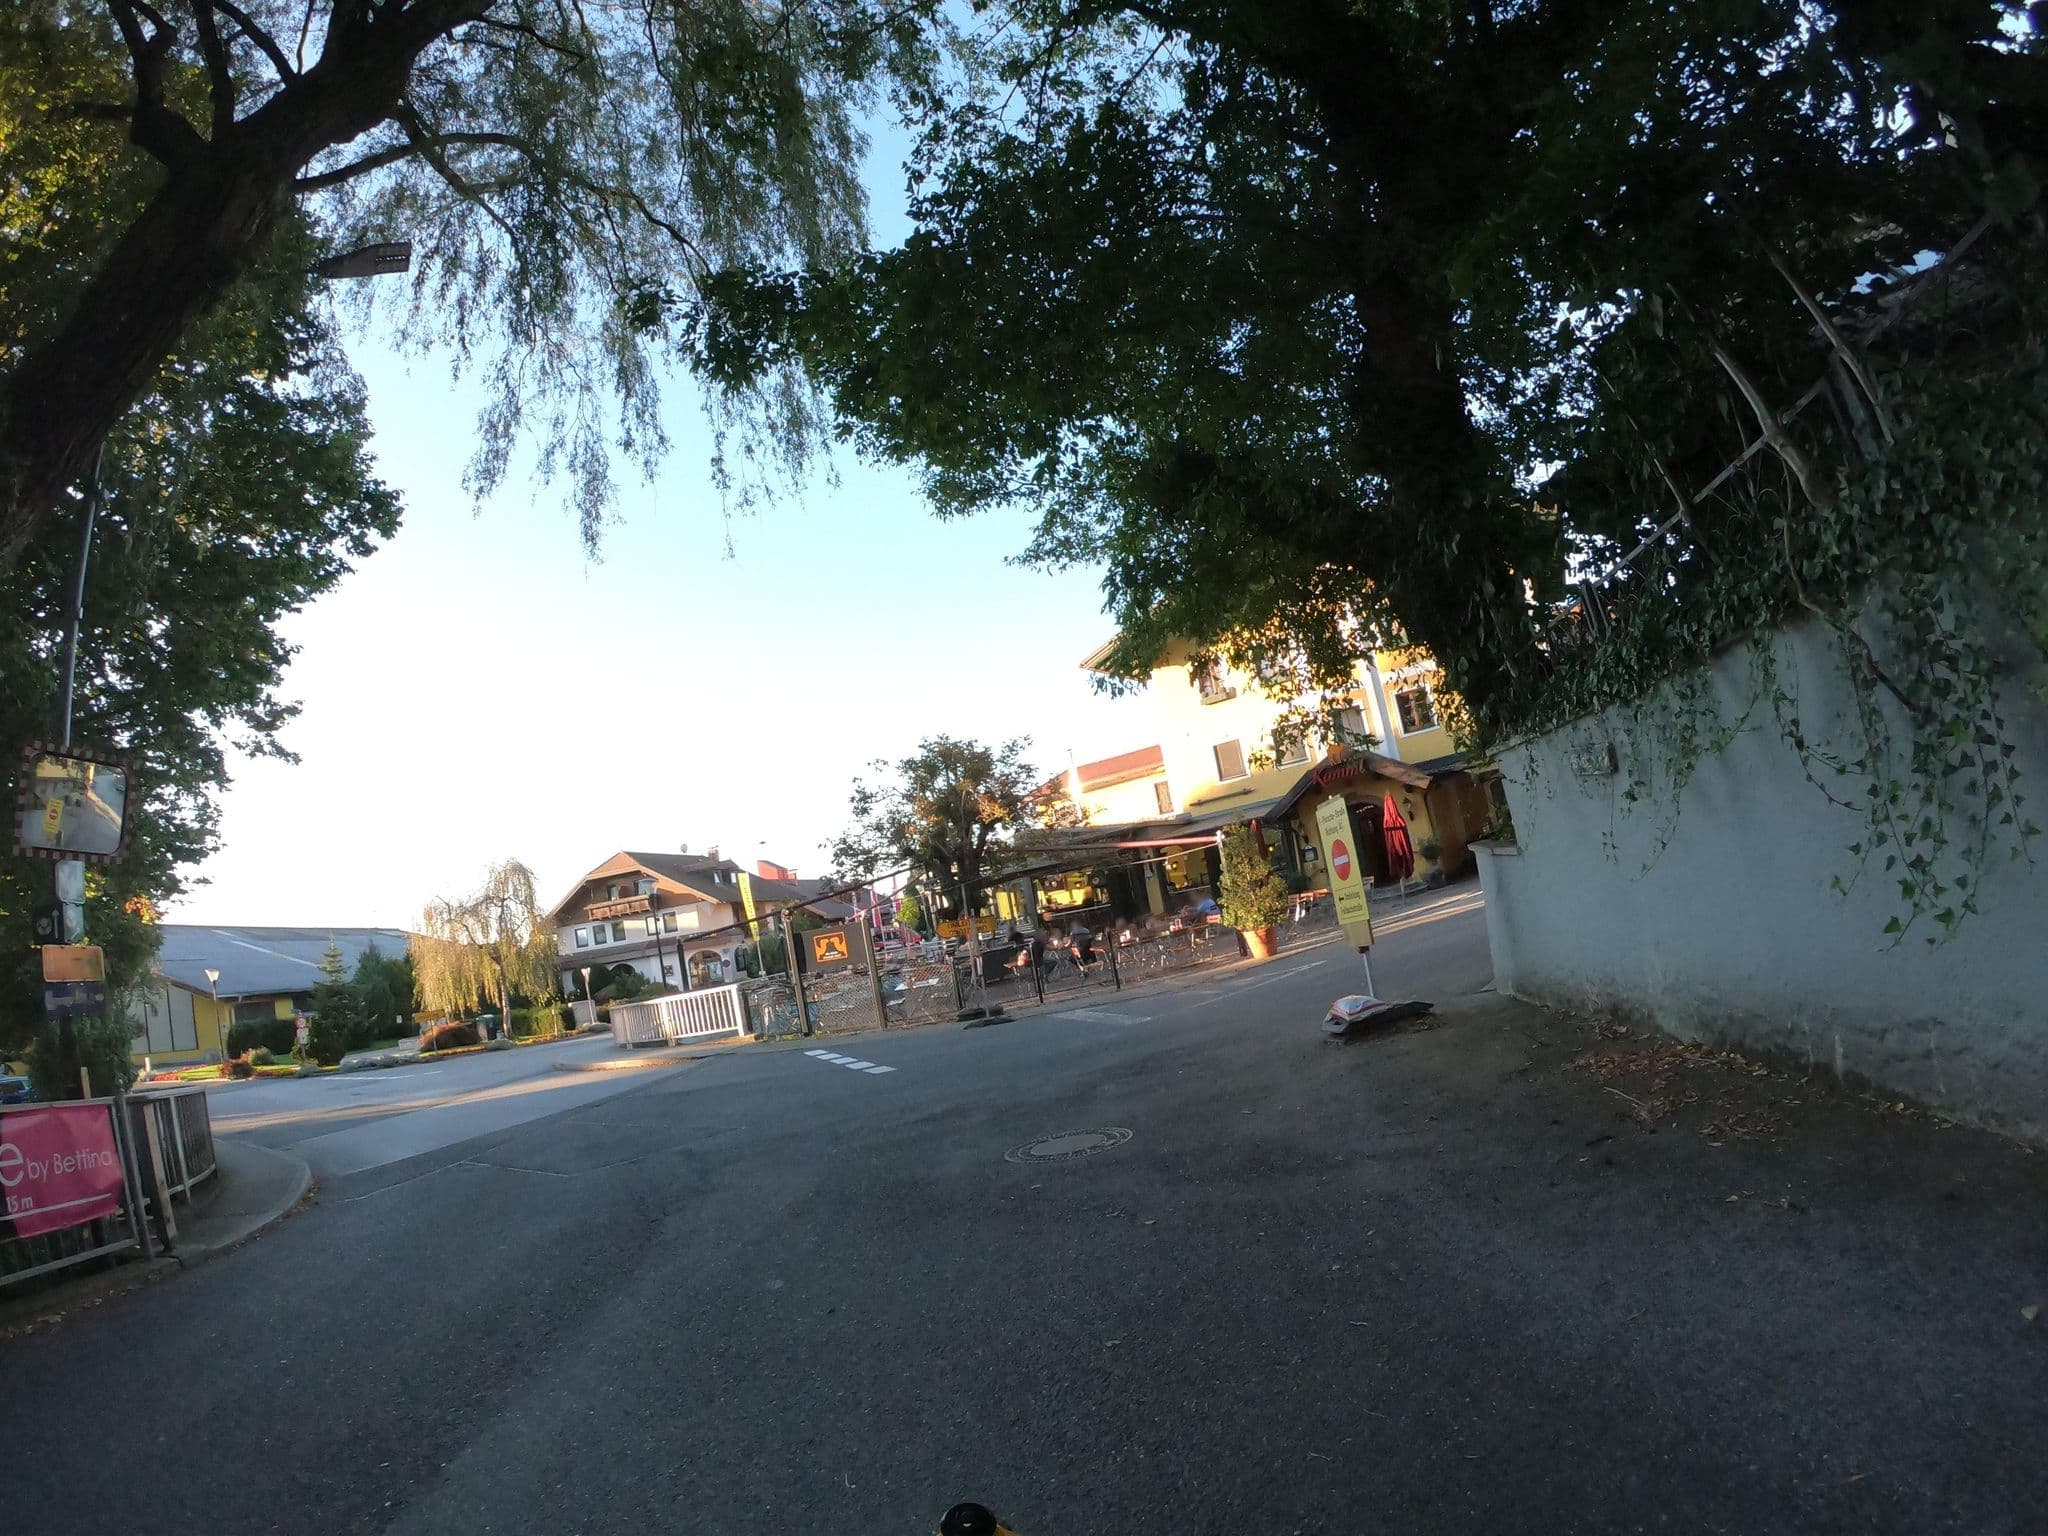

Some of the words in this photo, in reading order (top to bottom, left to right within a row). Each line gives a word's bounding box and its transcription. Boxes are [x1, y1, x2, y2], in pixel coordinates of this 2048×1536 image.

[26, 1158, 49, 1183] by
[53, 1148, 113, 1175] Bettina
[21, 1197, 33, 1209] m
